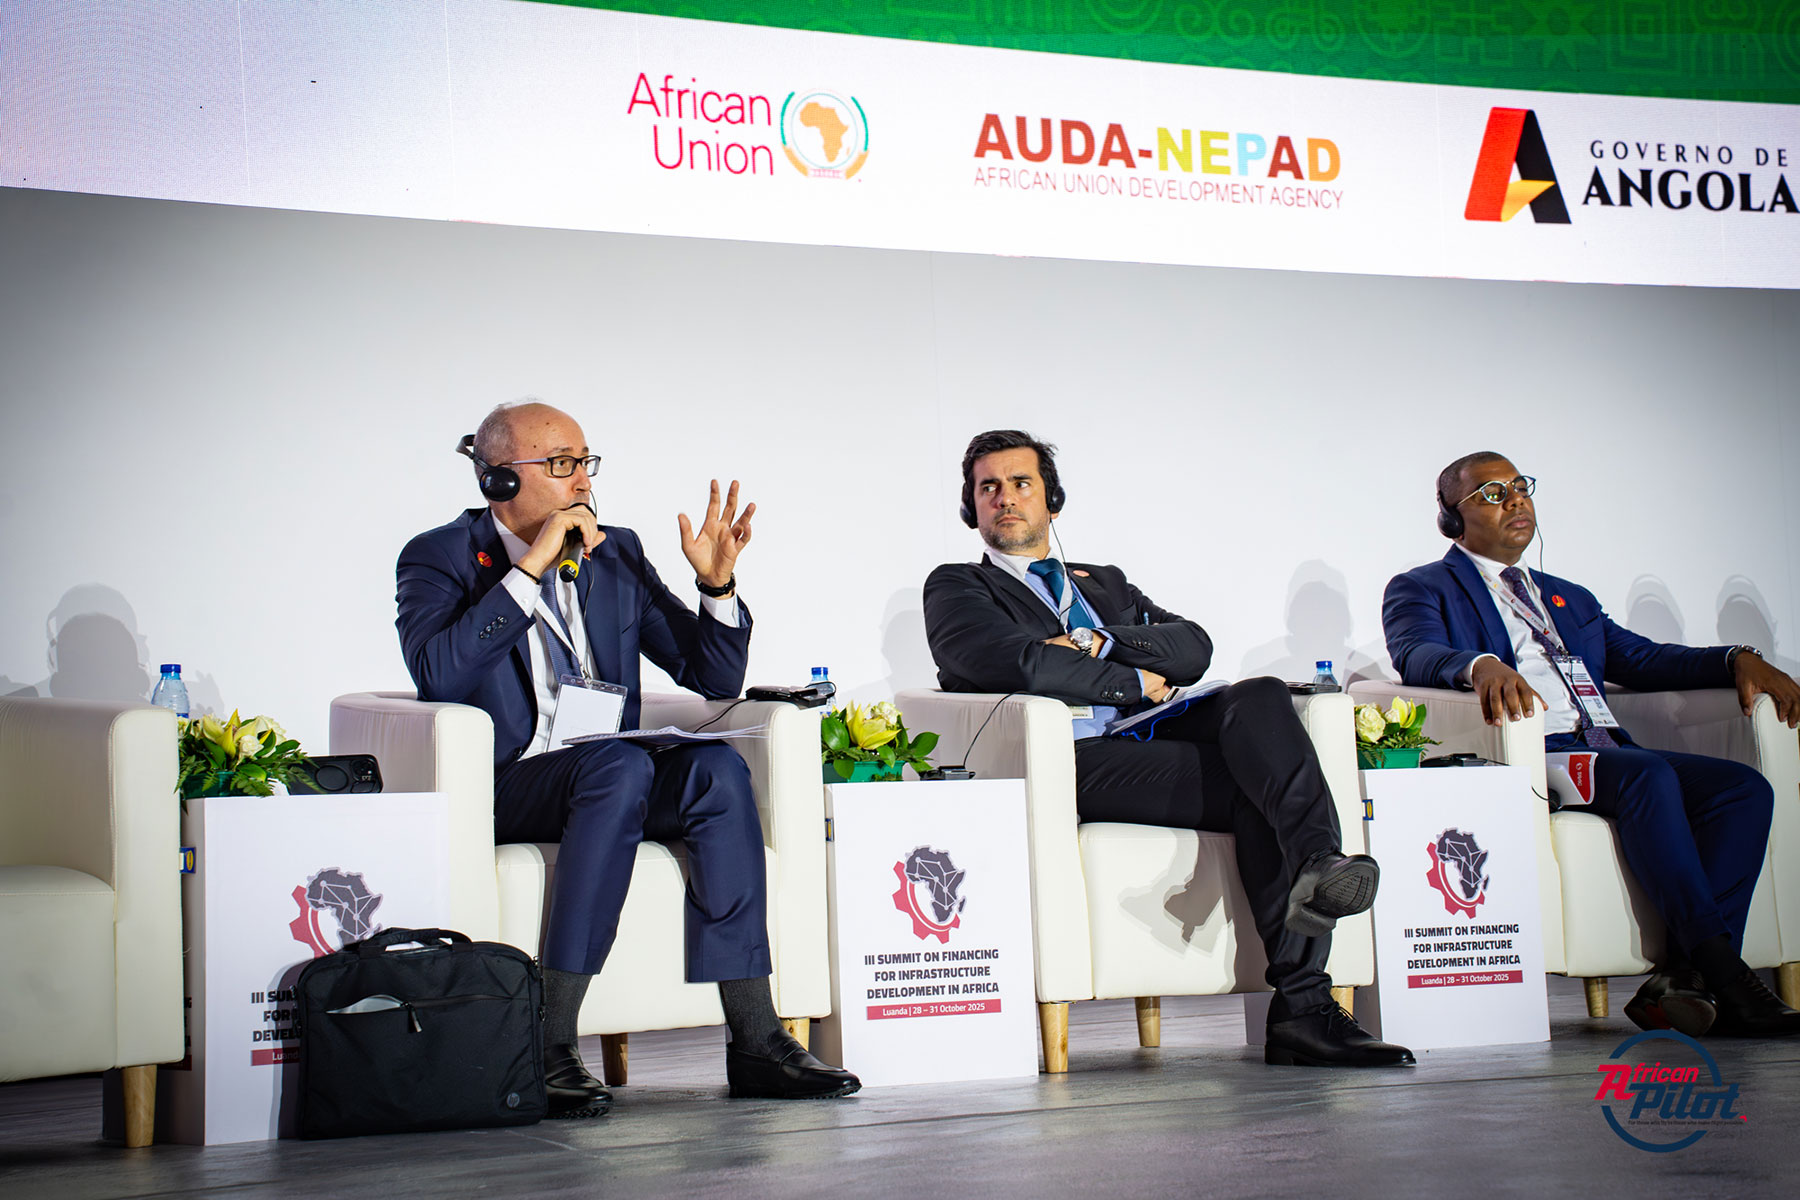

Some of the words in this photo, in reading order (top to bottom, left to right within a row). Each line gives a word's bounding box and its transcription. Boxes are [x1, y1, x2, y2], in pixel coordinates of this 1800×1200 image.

[627, 72, 772, 126] African
[653, 124, 774, 176] Union
[973, 113, 1342, 183] AUDA-NEPAD
[1590, 140, 1734, 165] GOVERNO
[1755, 148, 1789, 167] DE
[974, 167, 1057, 191] AFRICAN
[1063, 173, 1123, 195] UNION
[1129, 177, 1265, 204] DEVELOPMENT
[1269, 186, 1344, 209] AGENCY
[1582, 165, 1800, 213] ANGOLA
[1404, 928, 1414, 938] III
[1415, 926, 1453, 938] SUMMIT
[1454, 926, 1469, 936] ON
[1470, 924, 1520, 935] FINANCING
[1413, 943, 1432, 953] FOR
[1433, 939, 1513, 952] INFRASTRUCTURE
[864, 955, 875, 965] III
[877, 952, 922, 965] SUMMIT
[923, 951, 940, 963] ON
[942, 949, 999, 961] FINANCING
[1407, 956, 1475, 969] DEVELOPMENT
[1476, 956, 1487, 966] IN
[1488, 954, 1521, 965] AFRICA
[874, 970, 896, 982] FOR
[898, 966, 991, 980] INFRASTRUCTURE
[1421, 976, 1443, 985] Luanda
[1446, 976, 1455, 984] 28
[1461, 975, 1469, 983] 31
[1470, 974, 1493, 983] October
[1493, 973, 1510, 981] 2025
[251, 991, 265, 1004] III
[867, 985, 946, 999] DEVELOPMENT
[948, 984, 960, 995] IN
[962, 982, 999, 994] AFRICA
[263, 1009, 291, 1022] FOR
[882, 1007, 908, 1016] Luanda
[912, 1006, 922, 1014] 28
[929, 1005, 938, 1013] 31
[939, 1004, 967, 1013] October
[967, 1003, 985, 1011] 2025
